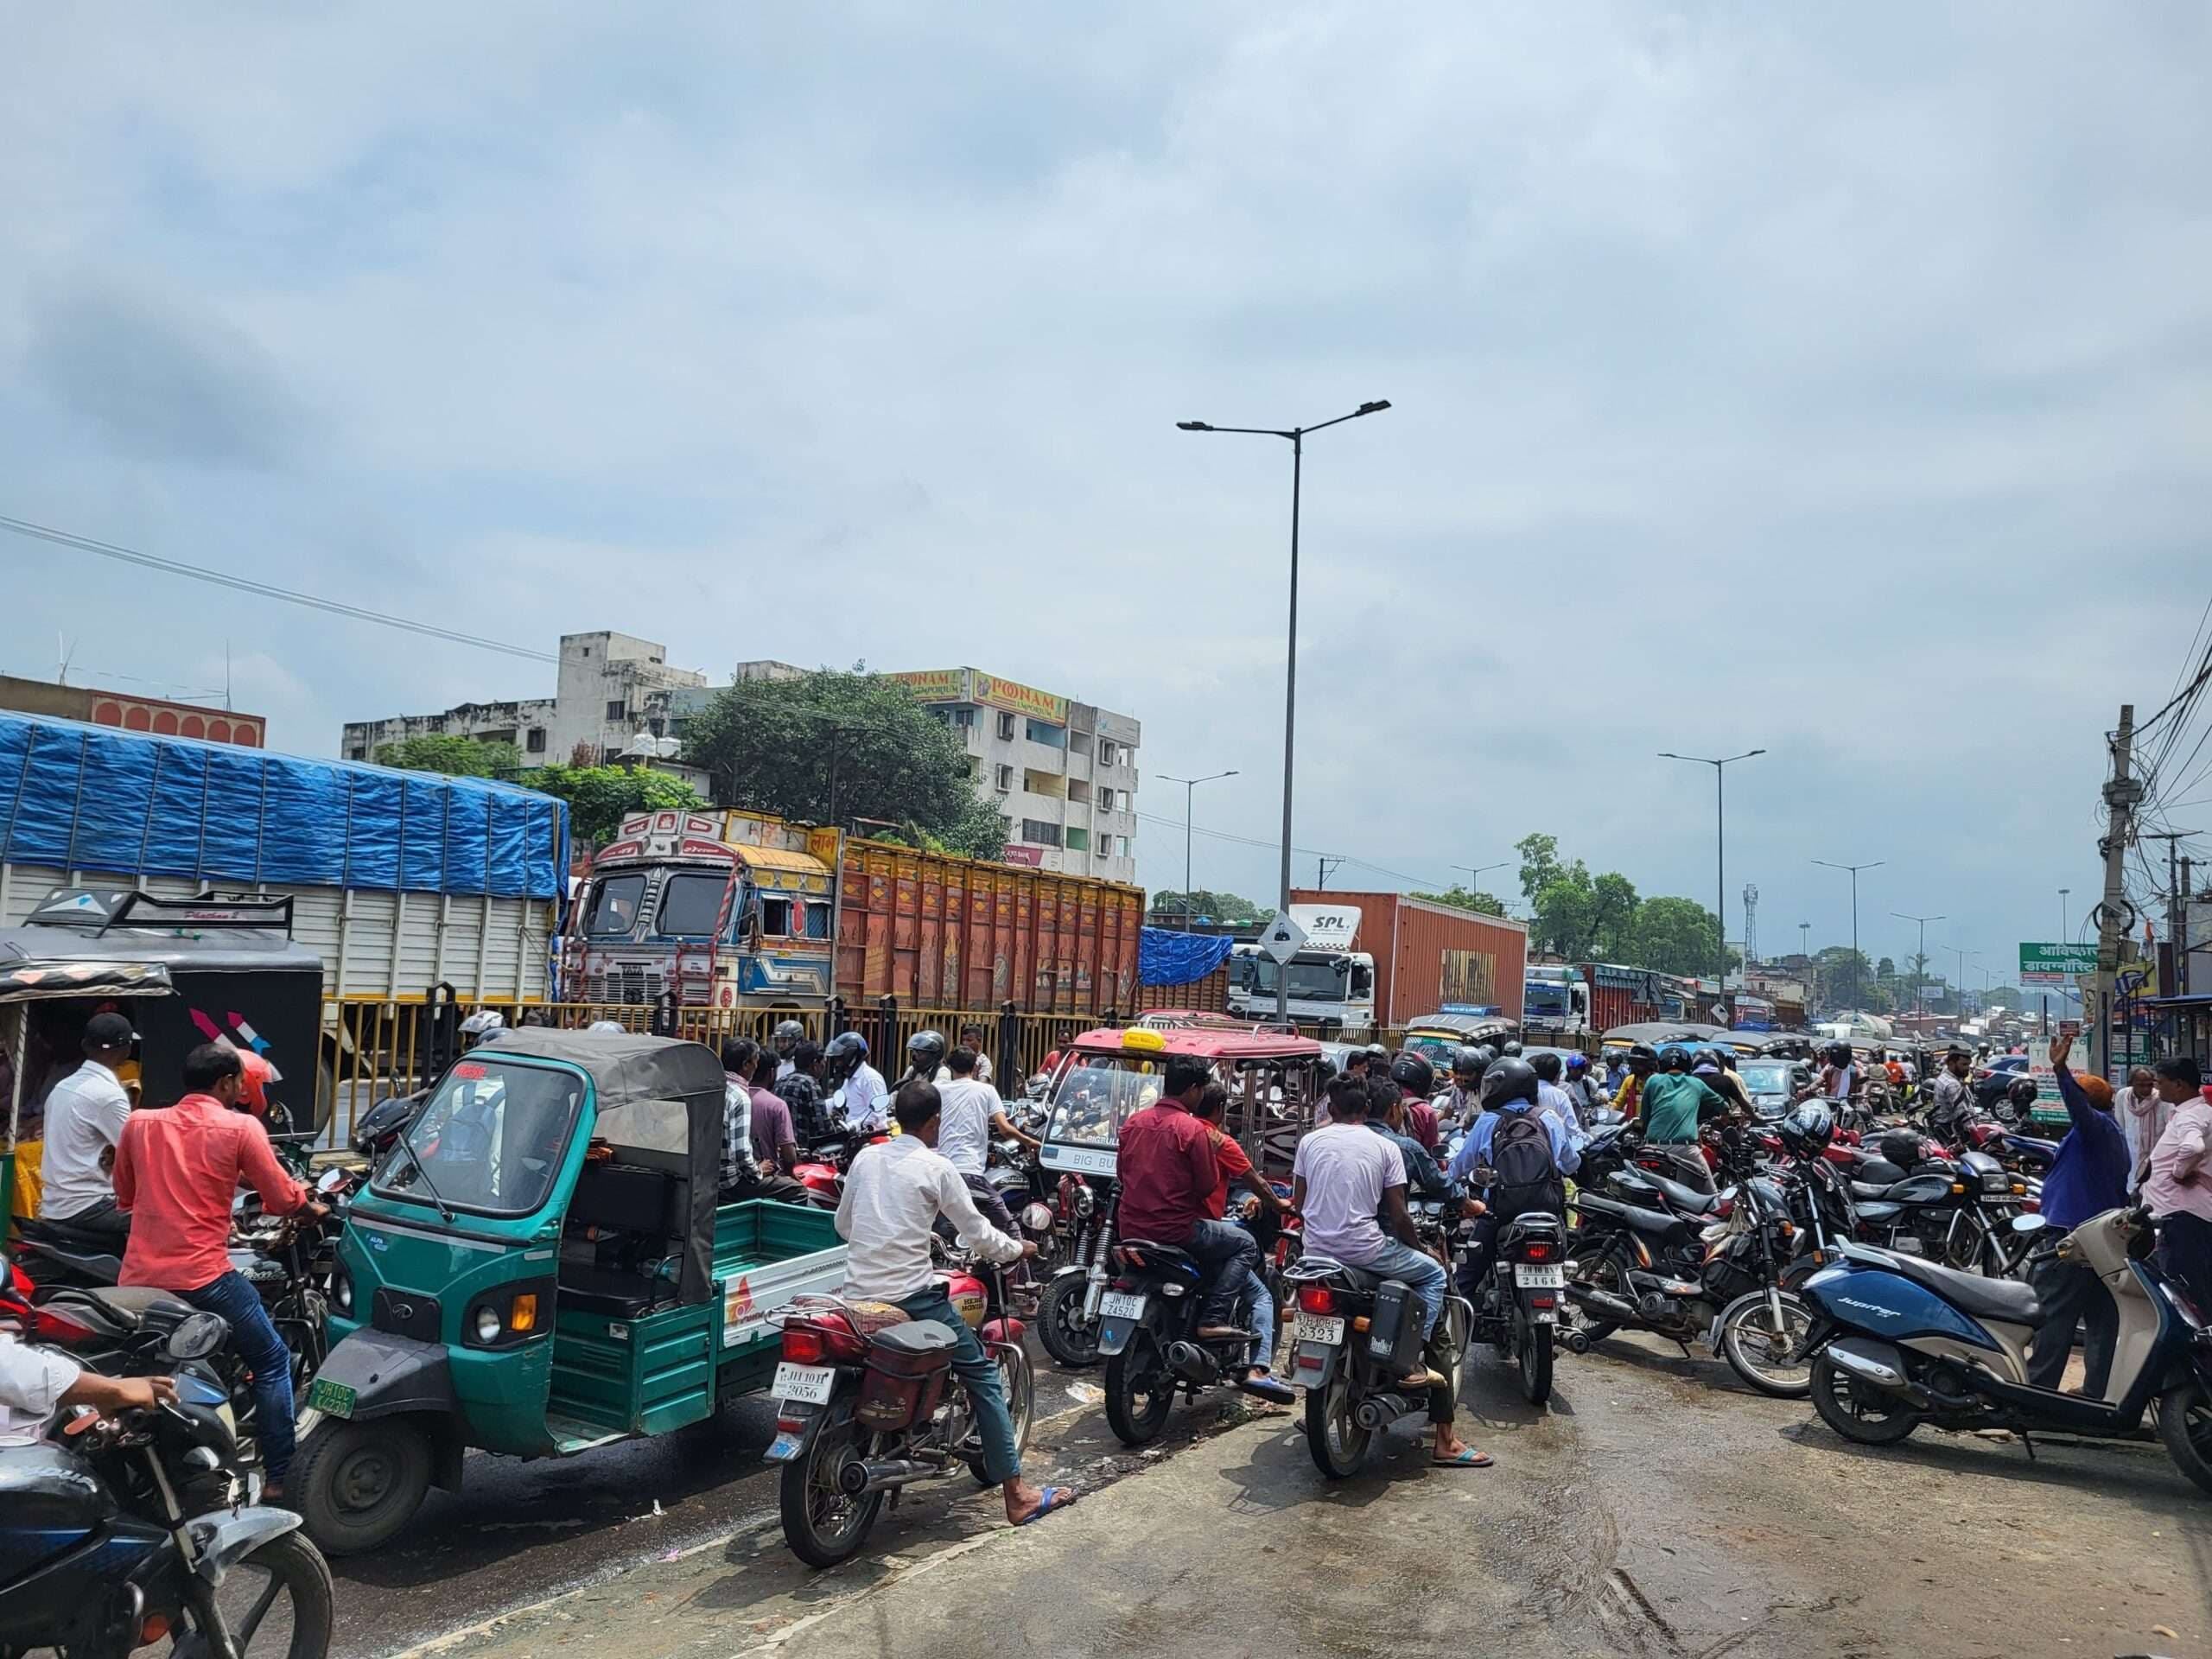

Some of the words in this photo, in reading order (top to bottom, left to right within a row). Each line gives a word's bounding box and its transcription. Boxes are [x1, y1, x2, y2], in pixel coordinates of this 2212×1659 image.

[991, 677, 1055, 711] POONAM
[810, 834, 837, 854] लाभ
[1073, 1154, 1093, 1166] BIG
[1109, 1295, 1138, 1307] JH10C
[1107, 1305, 1135, 1318] Z4520
[1299, 1326, 1335, 1342] 8323
[320, 1382, 351, 1402] JH10C
